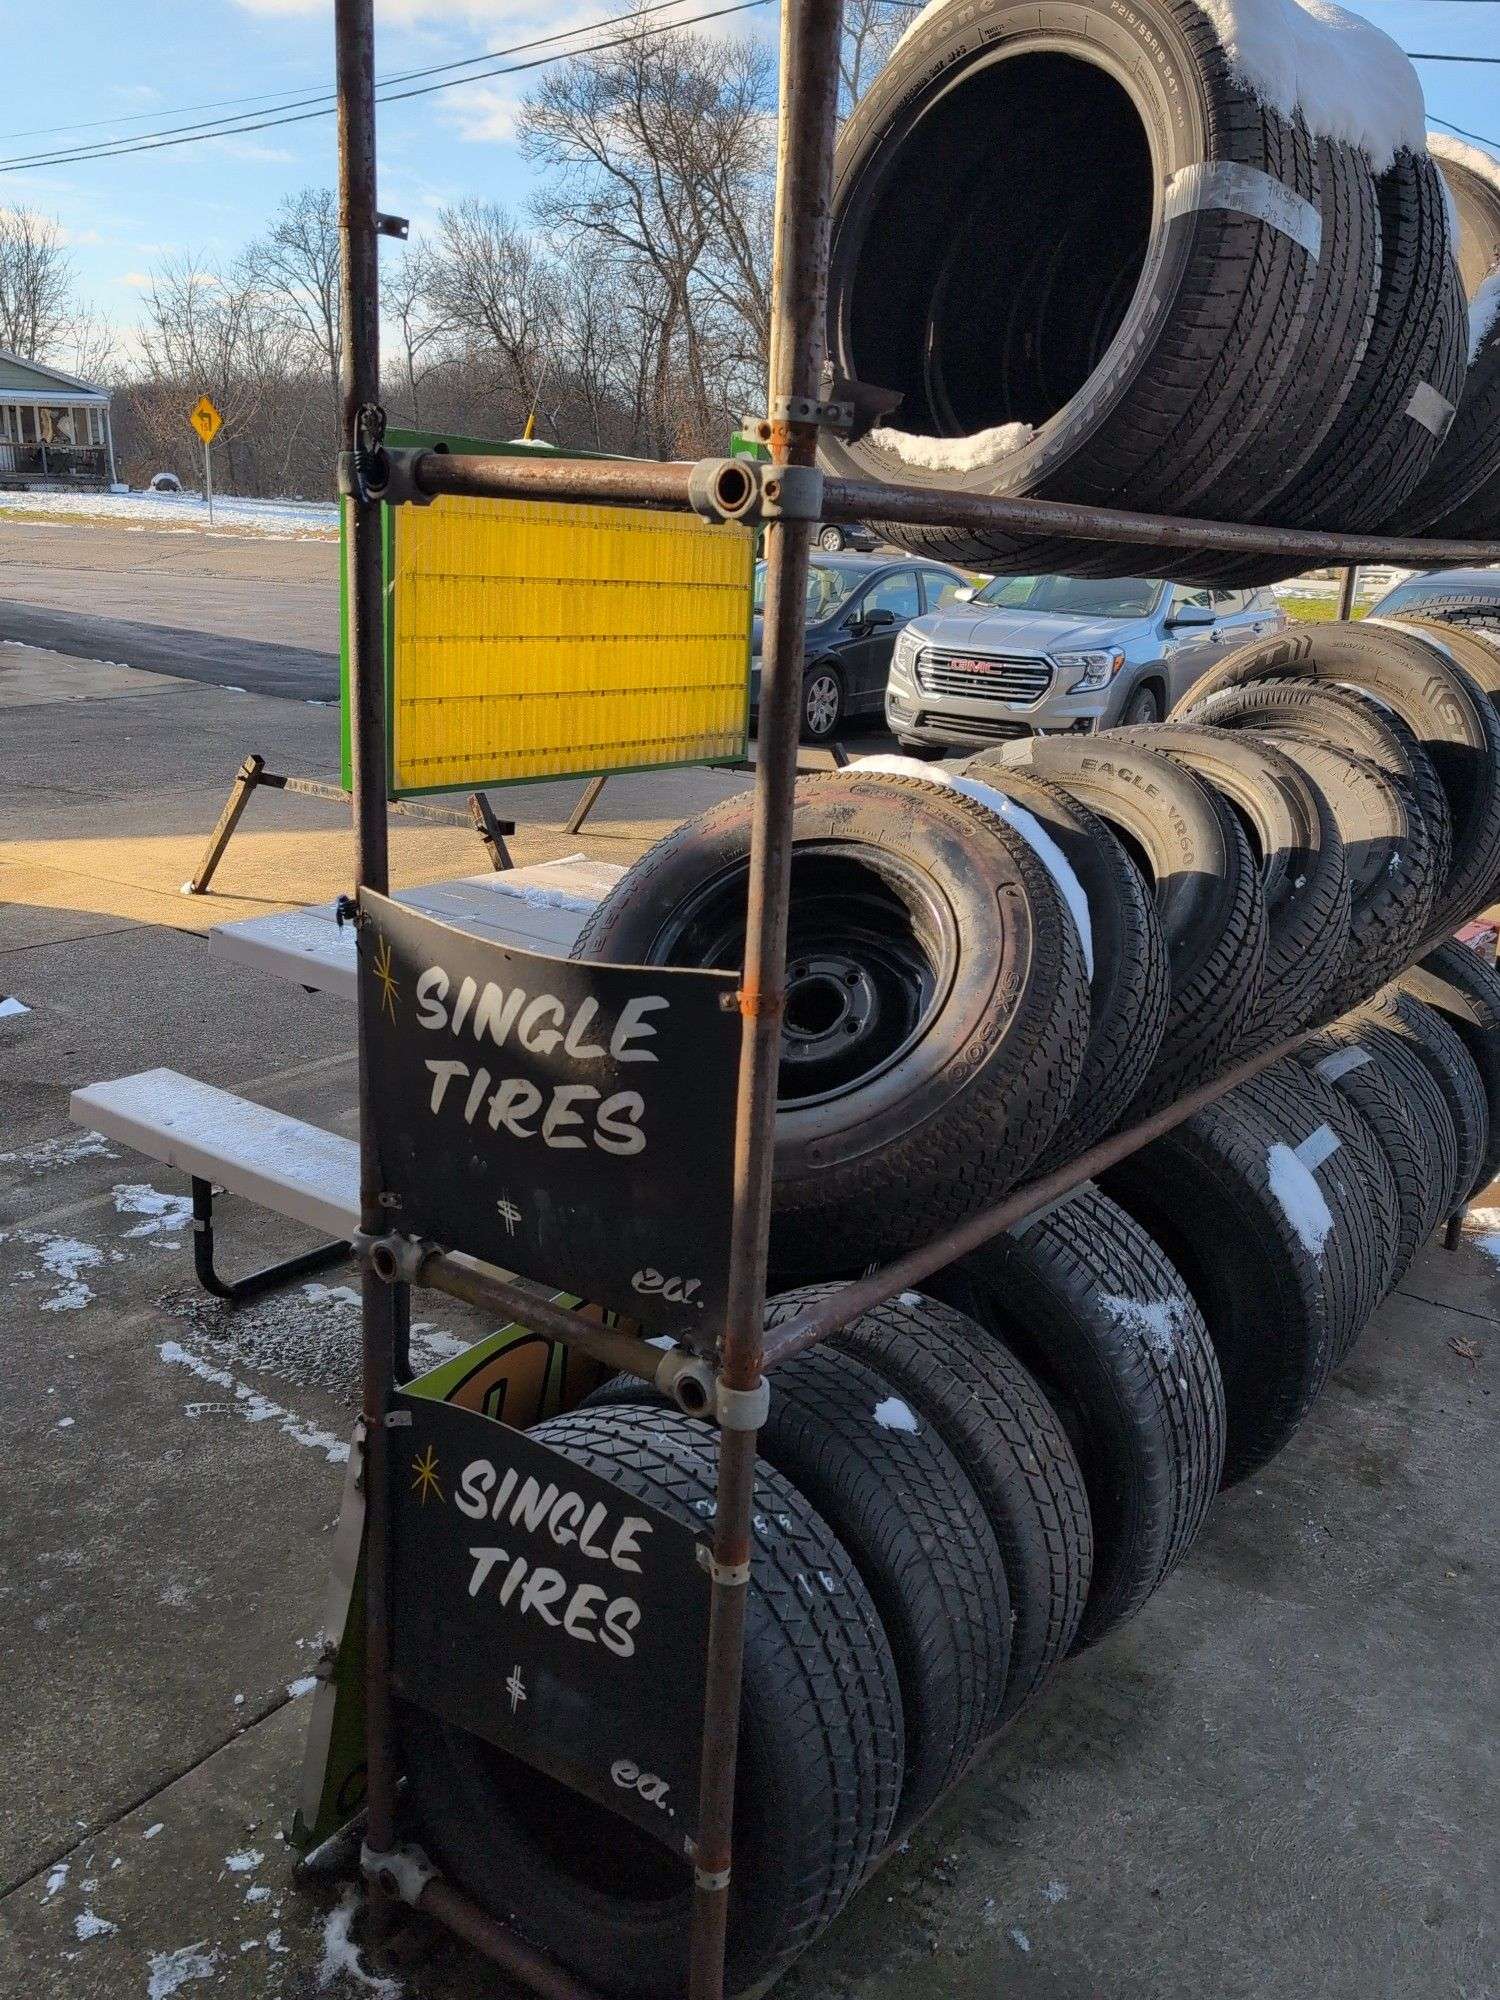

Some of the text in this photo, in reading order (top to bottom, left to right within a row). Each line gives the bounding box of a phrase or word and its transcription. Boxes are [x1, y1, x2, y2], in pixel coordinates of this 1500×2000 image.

[949, 657, 1003, 676] GMC
[1081, 757, 1160, 799] EAGLE
[416, 965, 670, 1062] SINGLE
[425, 1059, 648, 1156] TIRES
[454, 1458, 653, 1574] SINGLE
[468, 1547, 644, 1659] TIRES
